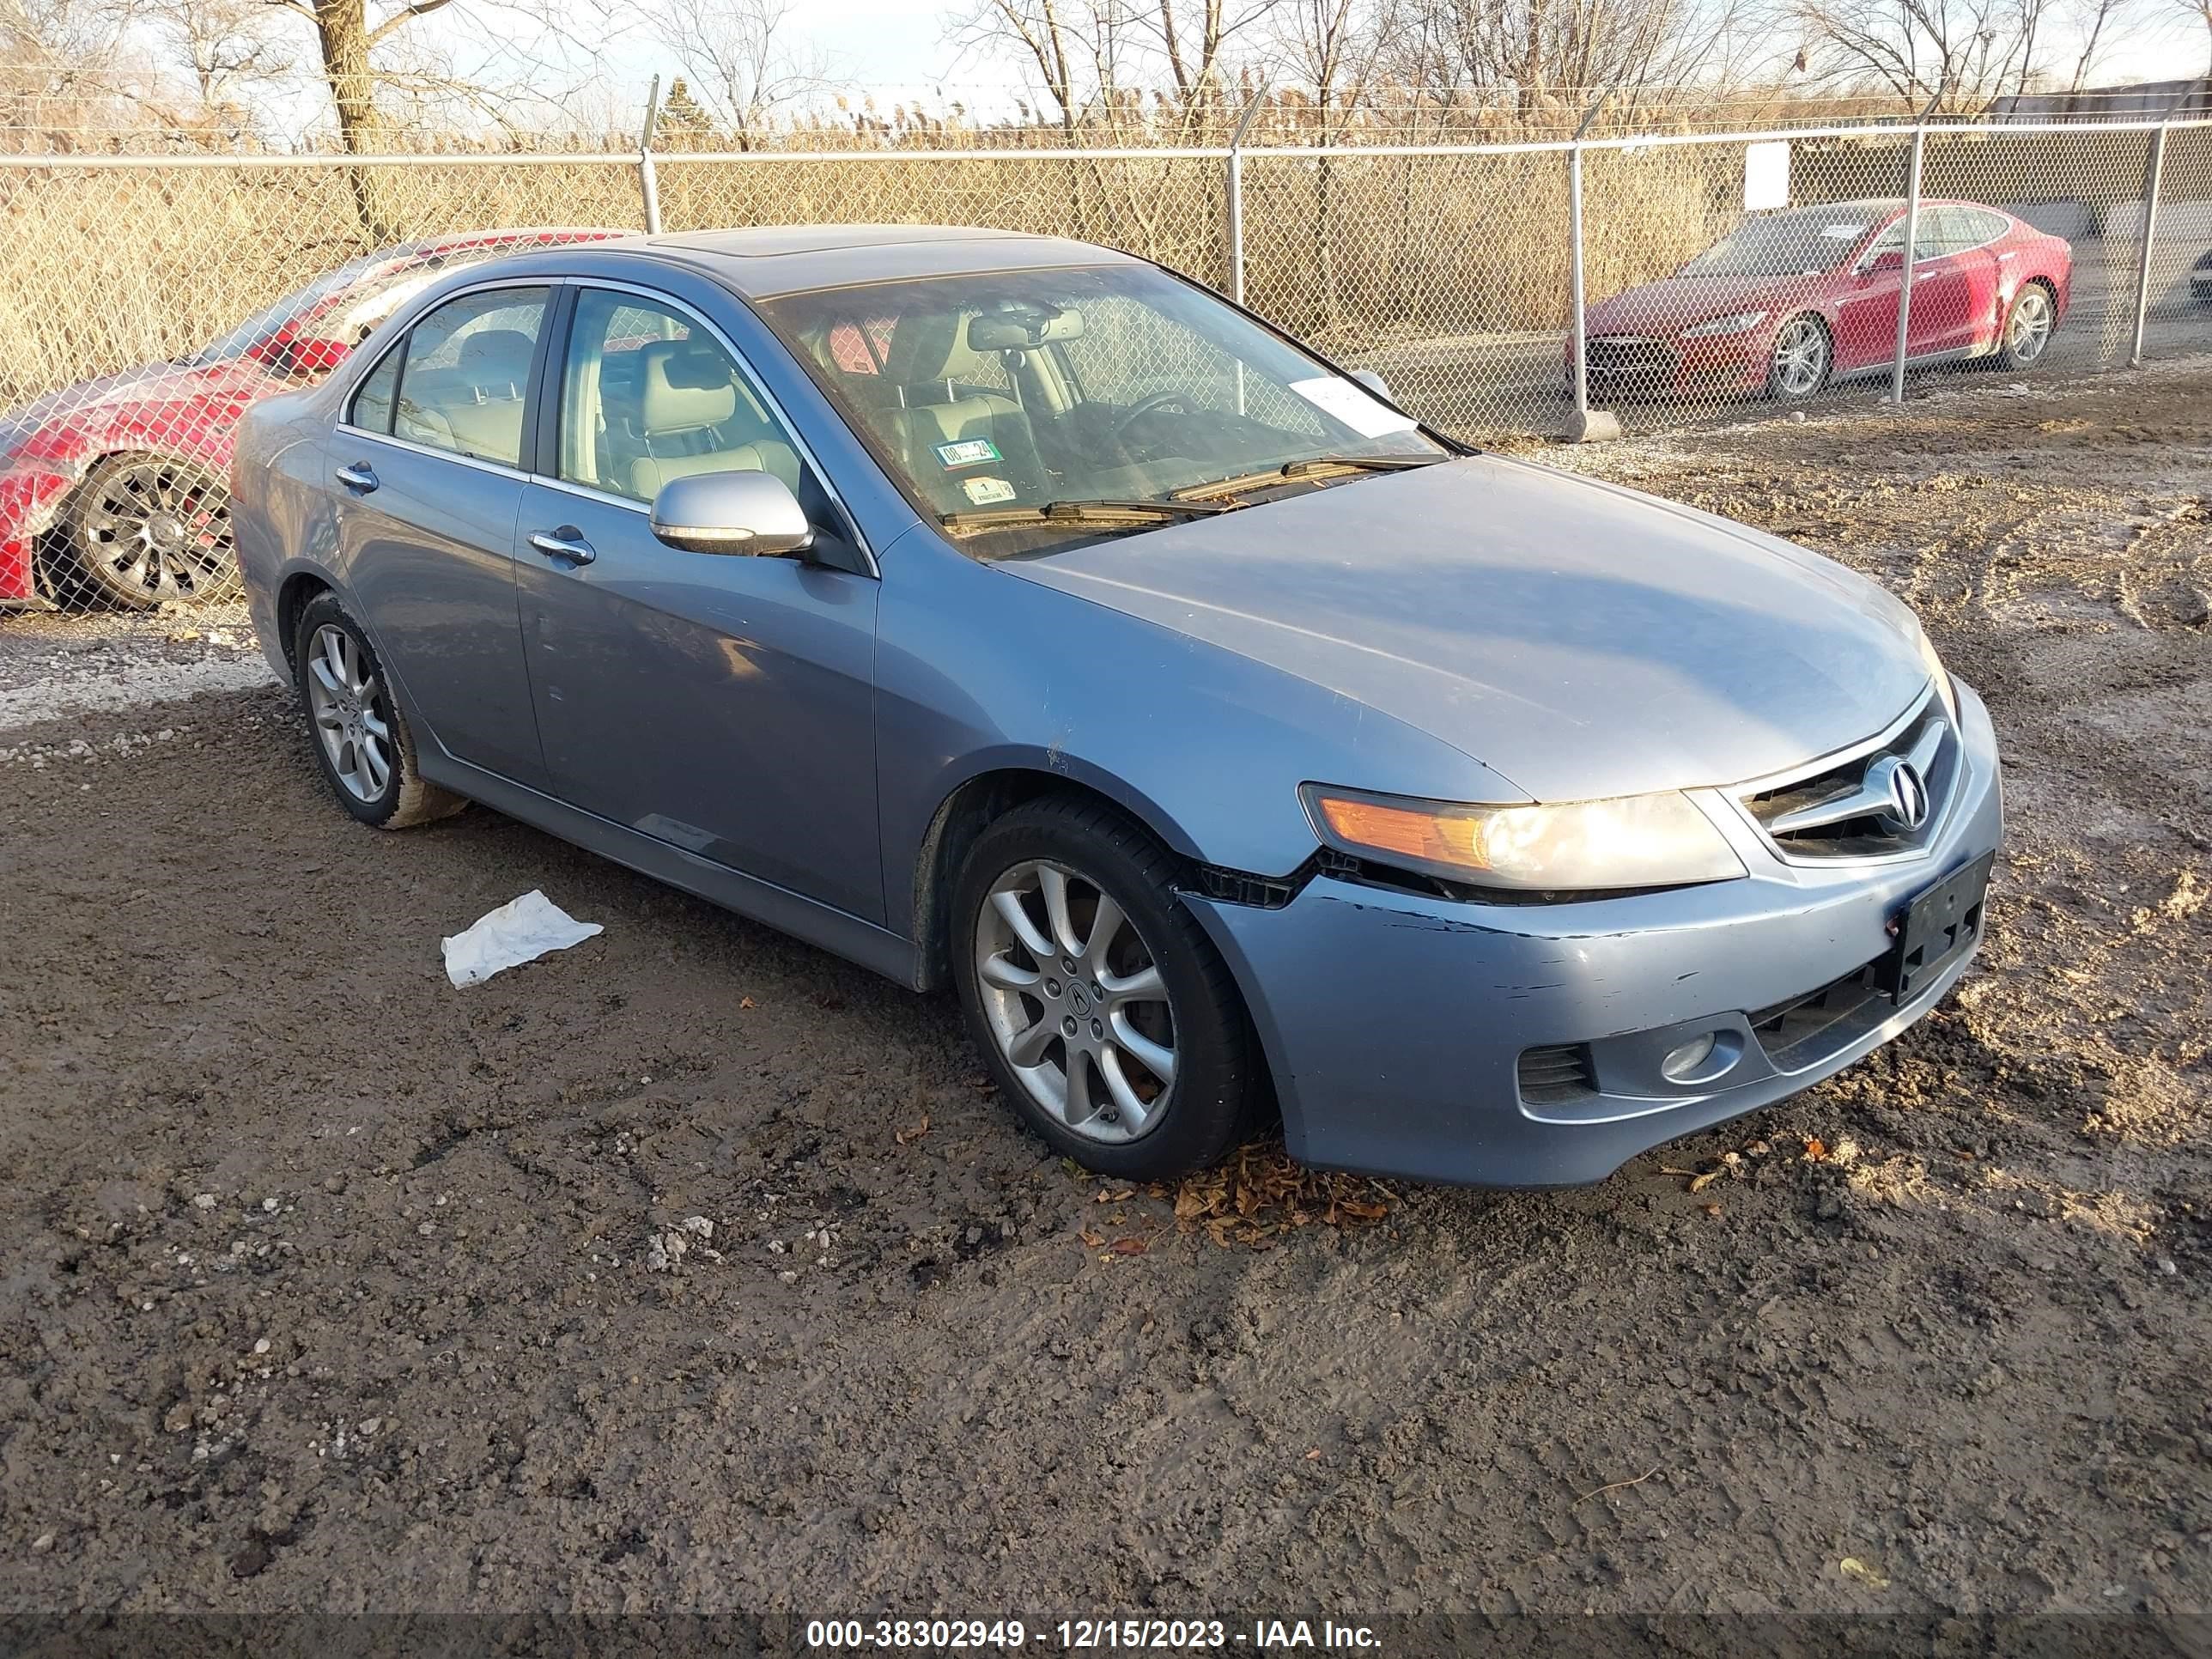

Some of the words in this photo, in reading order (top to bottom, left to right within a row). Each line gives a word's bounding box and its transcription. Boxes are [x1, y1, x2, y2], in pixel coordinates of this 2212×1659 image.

[943, 447, 962, 461] 08
[973, 441, 992, 457] 24
[980, 483, 988, 491] 1
